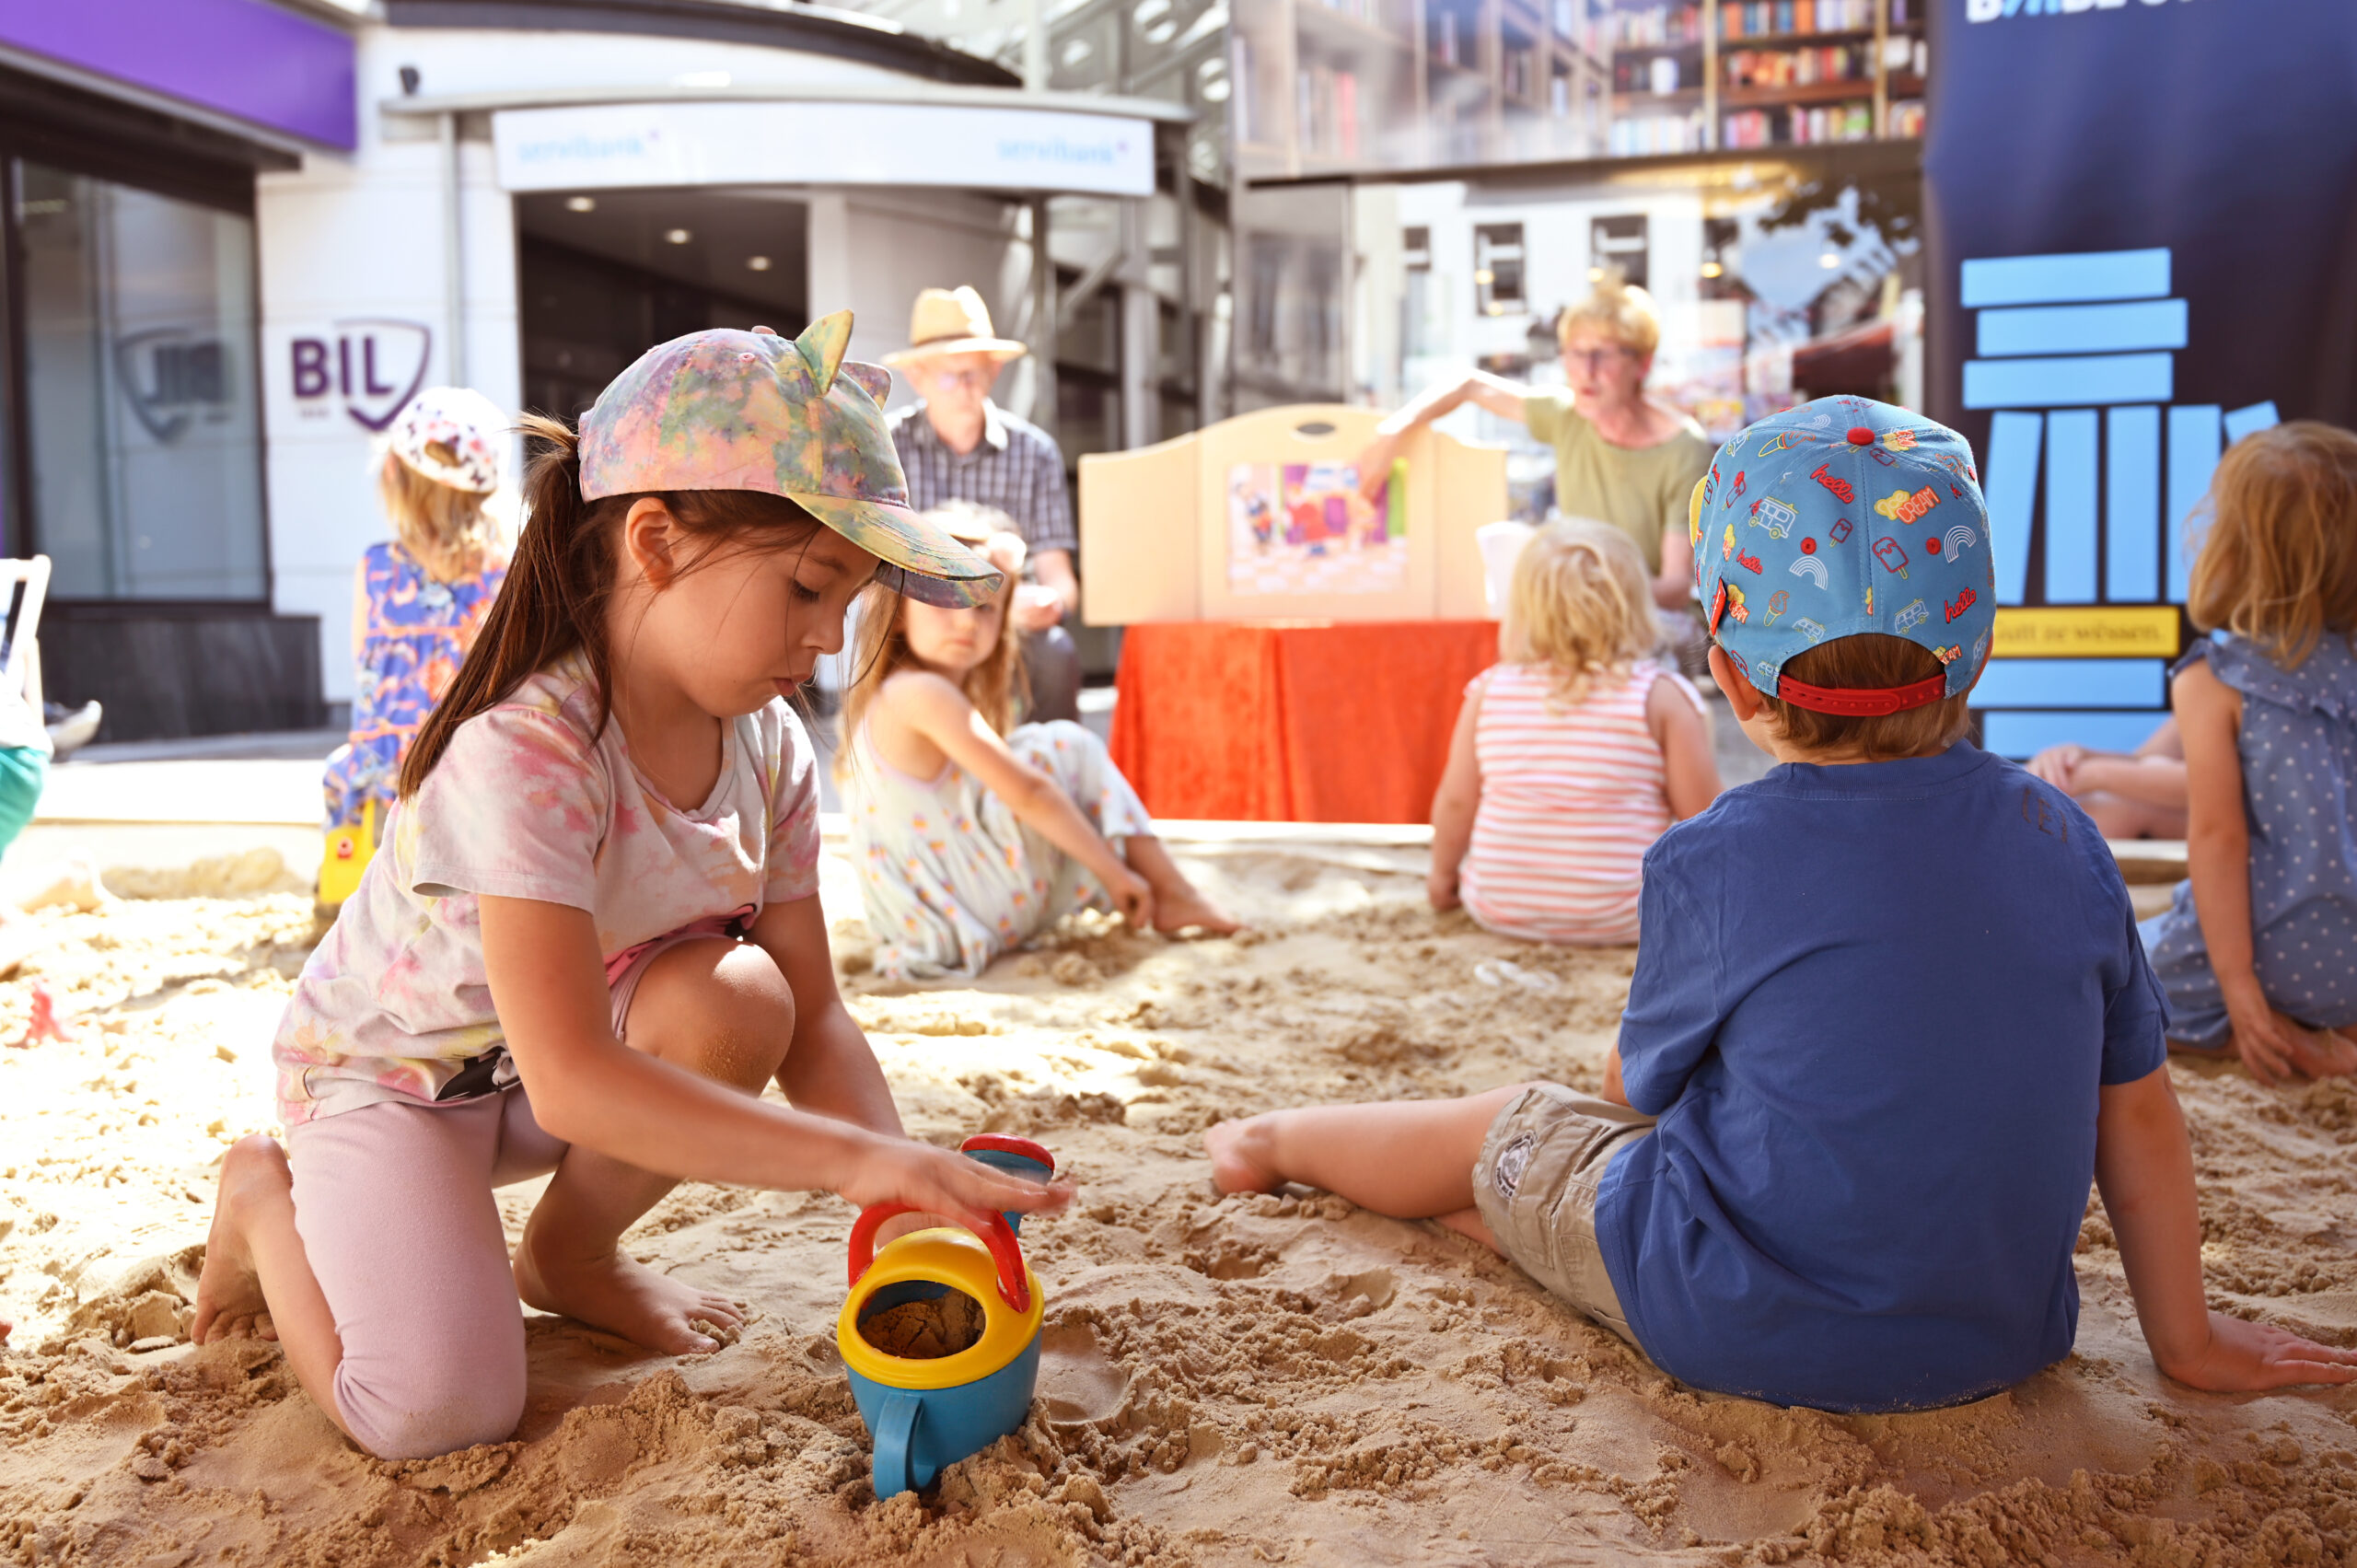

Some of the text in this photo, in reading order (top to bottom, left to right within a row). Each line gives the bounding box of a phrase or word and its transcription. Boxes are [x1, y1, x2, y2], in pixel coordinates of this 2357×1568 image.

[291, 336, 395, 399] BIL
[1810, 463, 1855, 505] hello
[1894, 484, 1942, 526] CREAM
[1736, 548, 1763, 575] hello
[1945, 587, 1977, 623] hello
